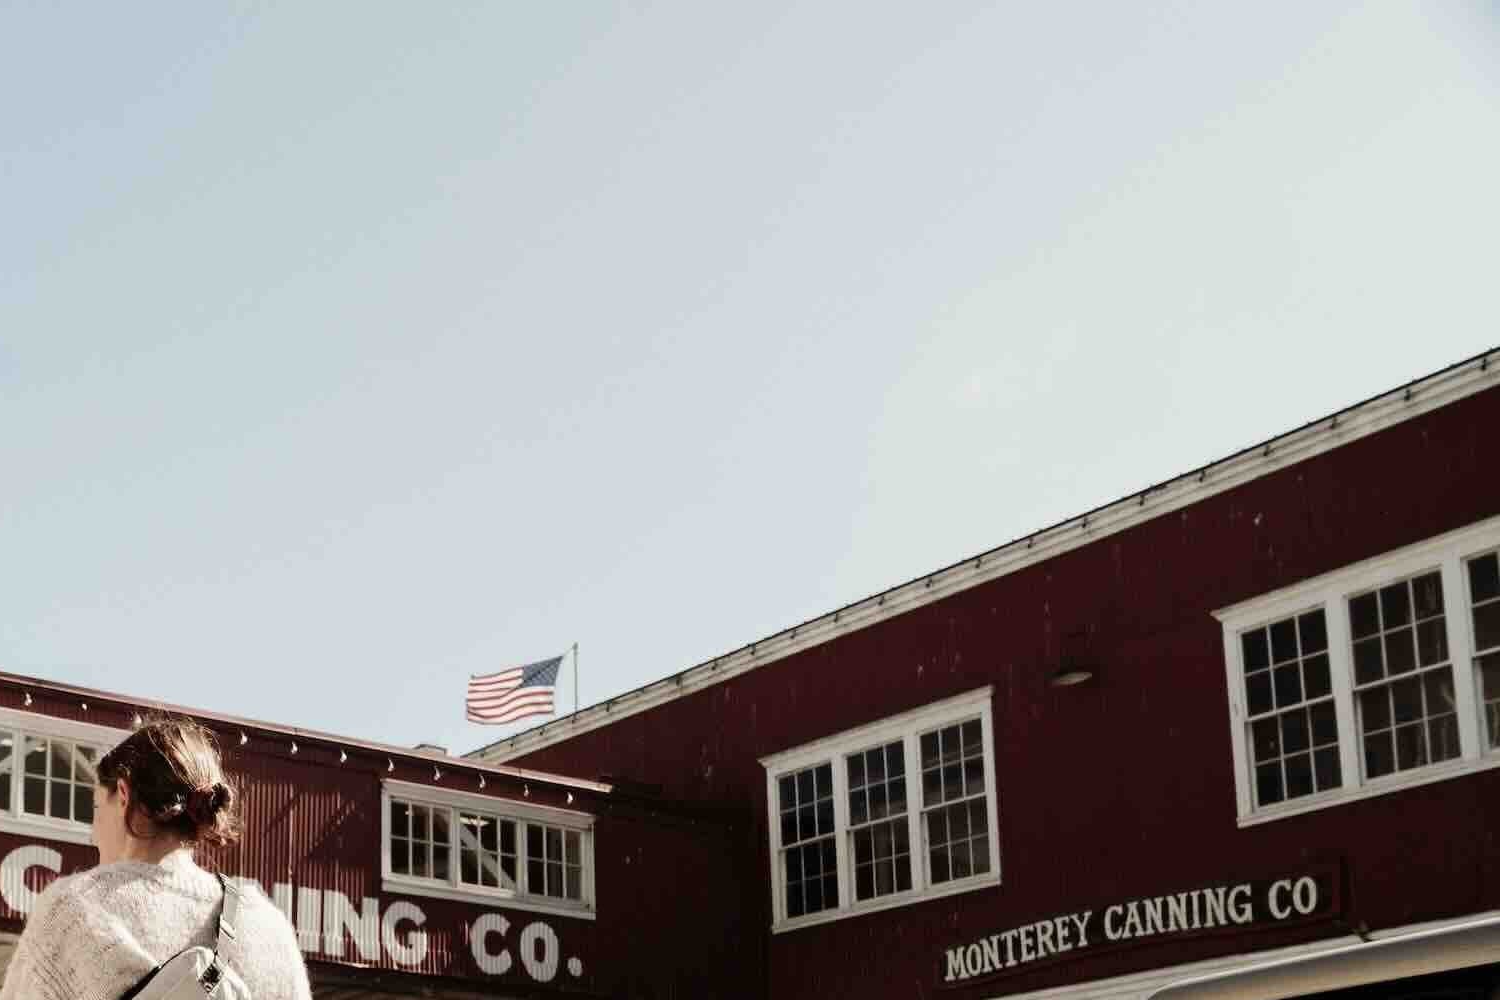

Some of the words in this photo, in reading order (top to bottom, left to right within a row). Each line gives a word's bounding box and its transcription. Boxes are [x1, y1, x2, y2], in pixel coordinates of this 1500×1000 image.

[0, 845, 428, 966] CING
[468, 912, 584, 983] CO.
[943, 910, 1093, 983] MONTEREY
[1104, 882, 1254, 941] CANNING
[1267, 876, 1318, 920] CO
